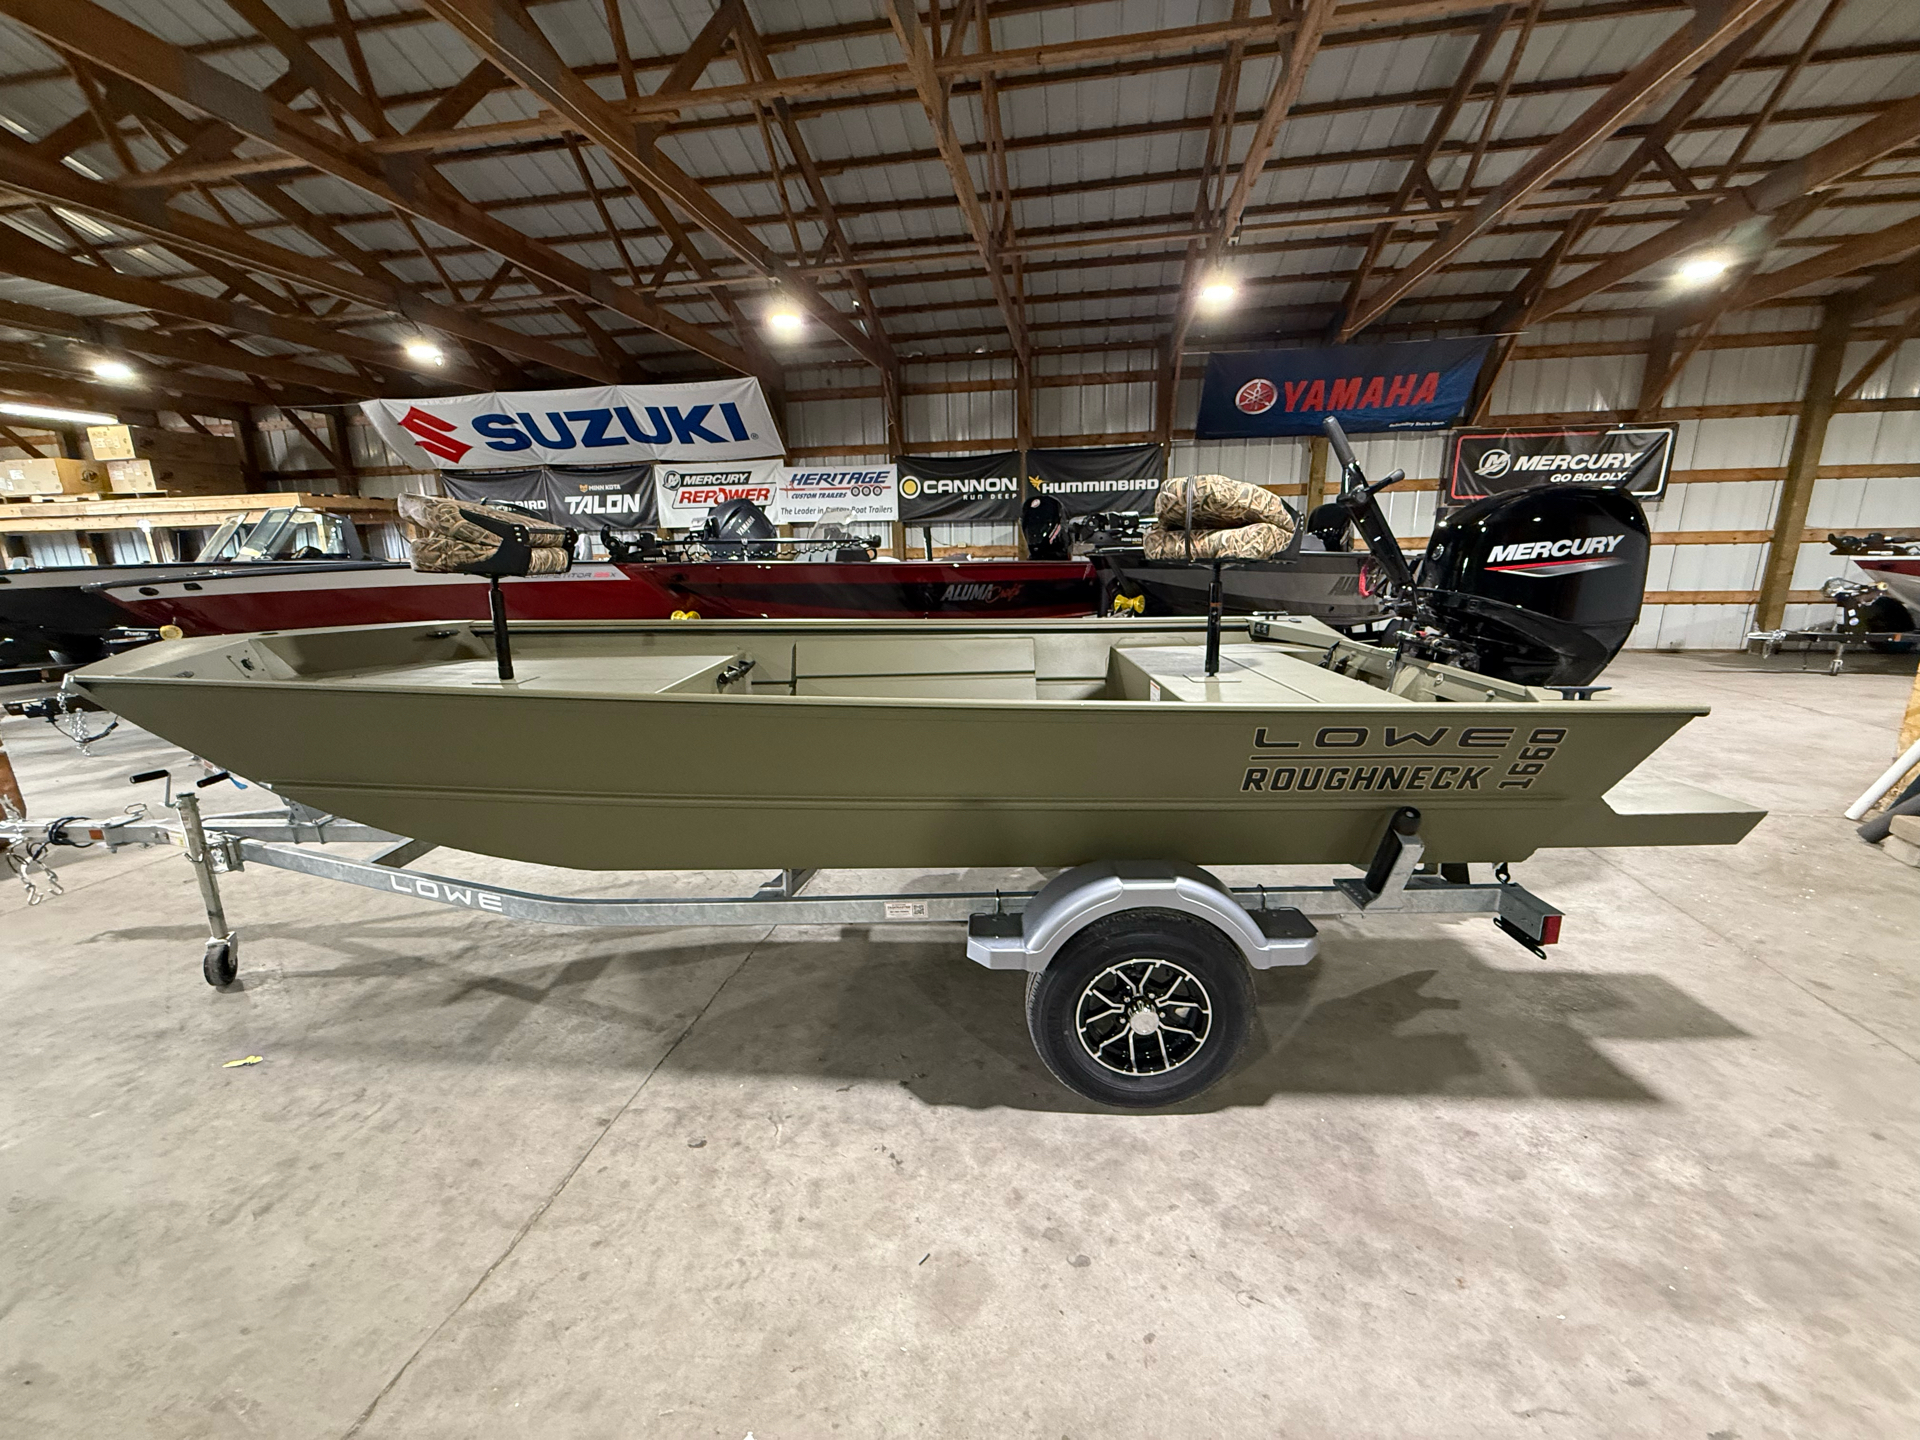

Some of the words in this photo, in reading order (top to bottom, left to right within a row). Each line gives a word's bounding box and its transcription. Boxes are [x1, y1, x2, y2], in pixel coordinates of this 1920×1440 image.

[1284, 372, 1440, 413] YAMAHA
[471, 402, 750, 452] SUZUKI
[1513, 452, 1644, 472] MERCURY
[683, 473, 748, 485] MERCURY
[791, 471, 890, 486] HERITAGE
[923, 477, 1018, 494] CANNON
[1042, 478, 1159, 494] HUMMINBIRD
[1550, 473, 1570, 482] GO
[564, 493, 641, 515] TALON
[679, 487, 770, 505] REPOWER
[818, 491, 848, 499] TRAILERS
[781, 507, 792, 515] The
[794, 507, 816, 515] Leader
[869, 505, 893, 513] Trailers
[1487, 534, 1625, 563] MERCURY
[1254, 727, 1516, 748] LOWE
[1498, 727, 1568, 790] 1660
[1240, 766, 1494, 792] ROUGHNECK
[390, 875, 503, 912] LOWE
